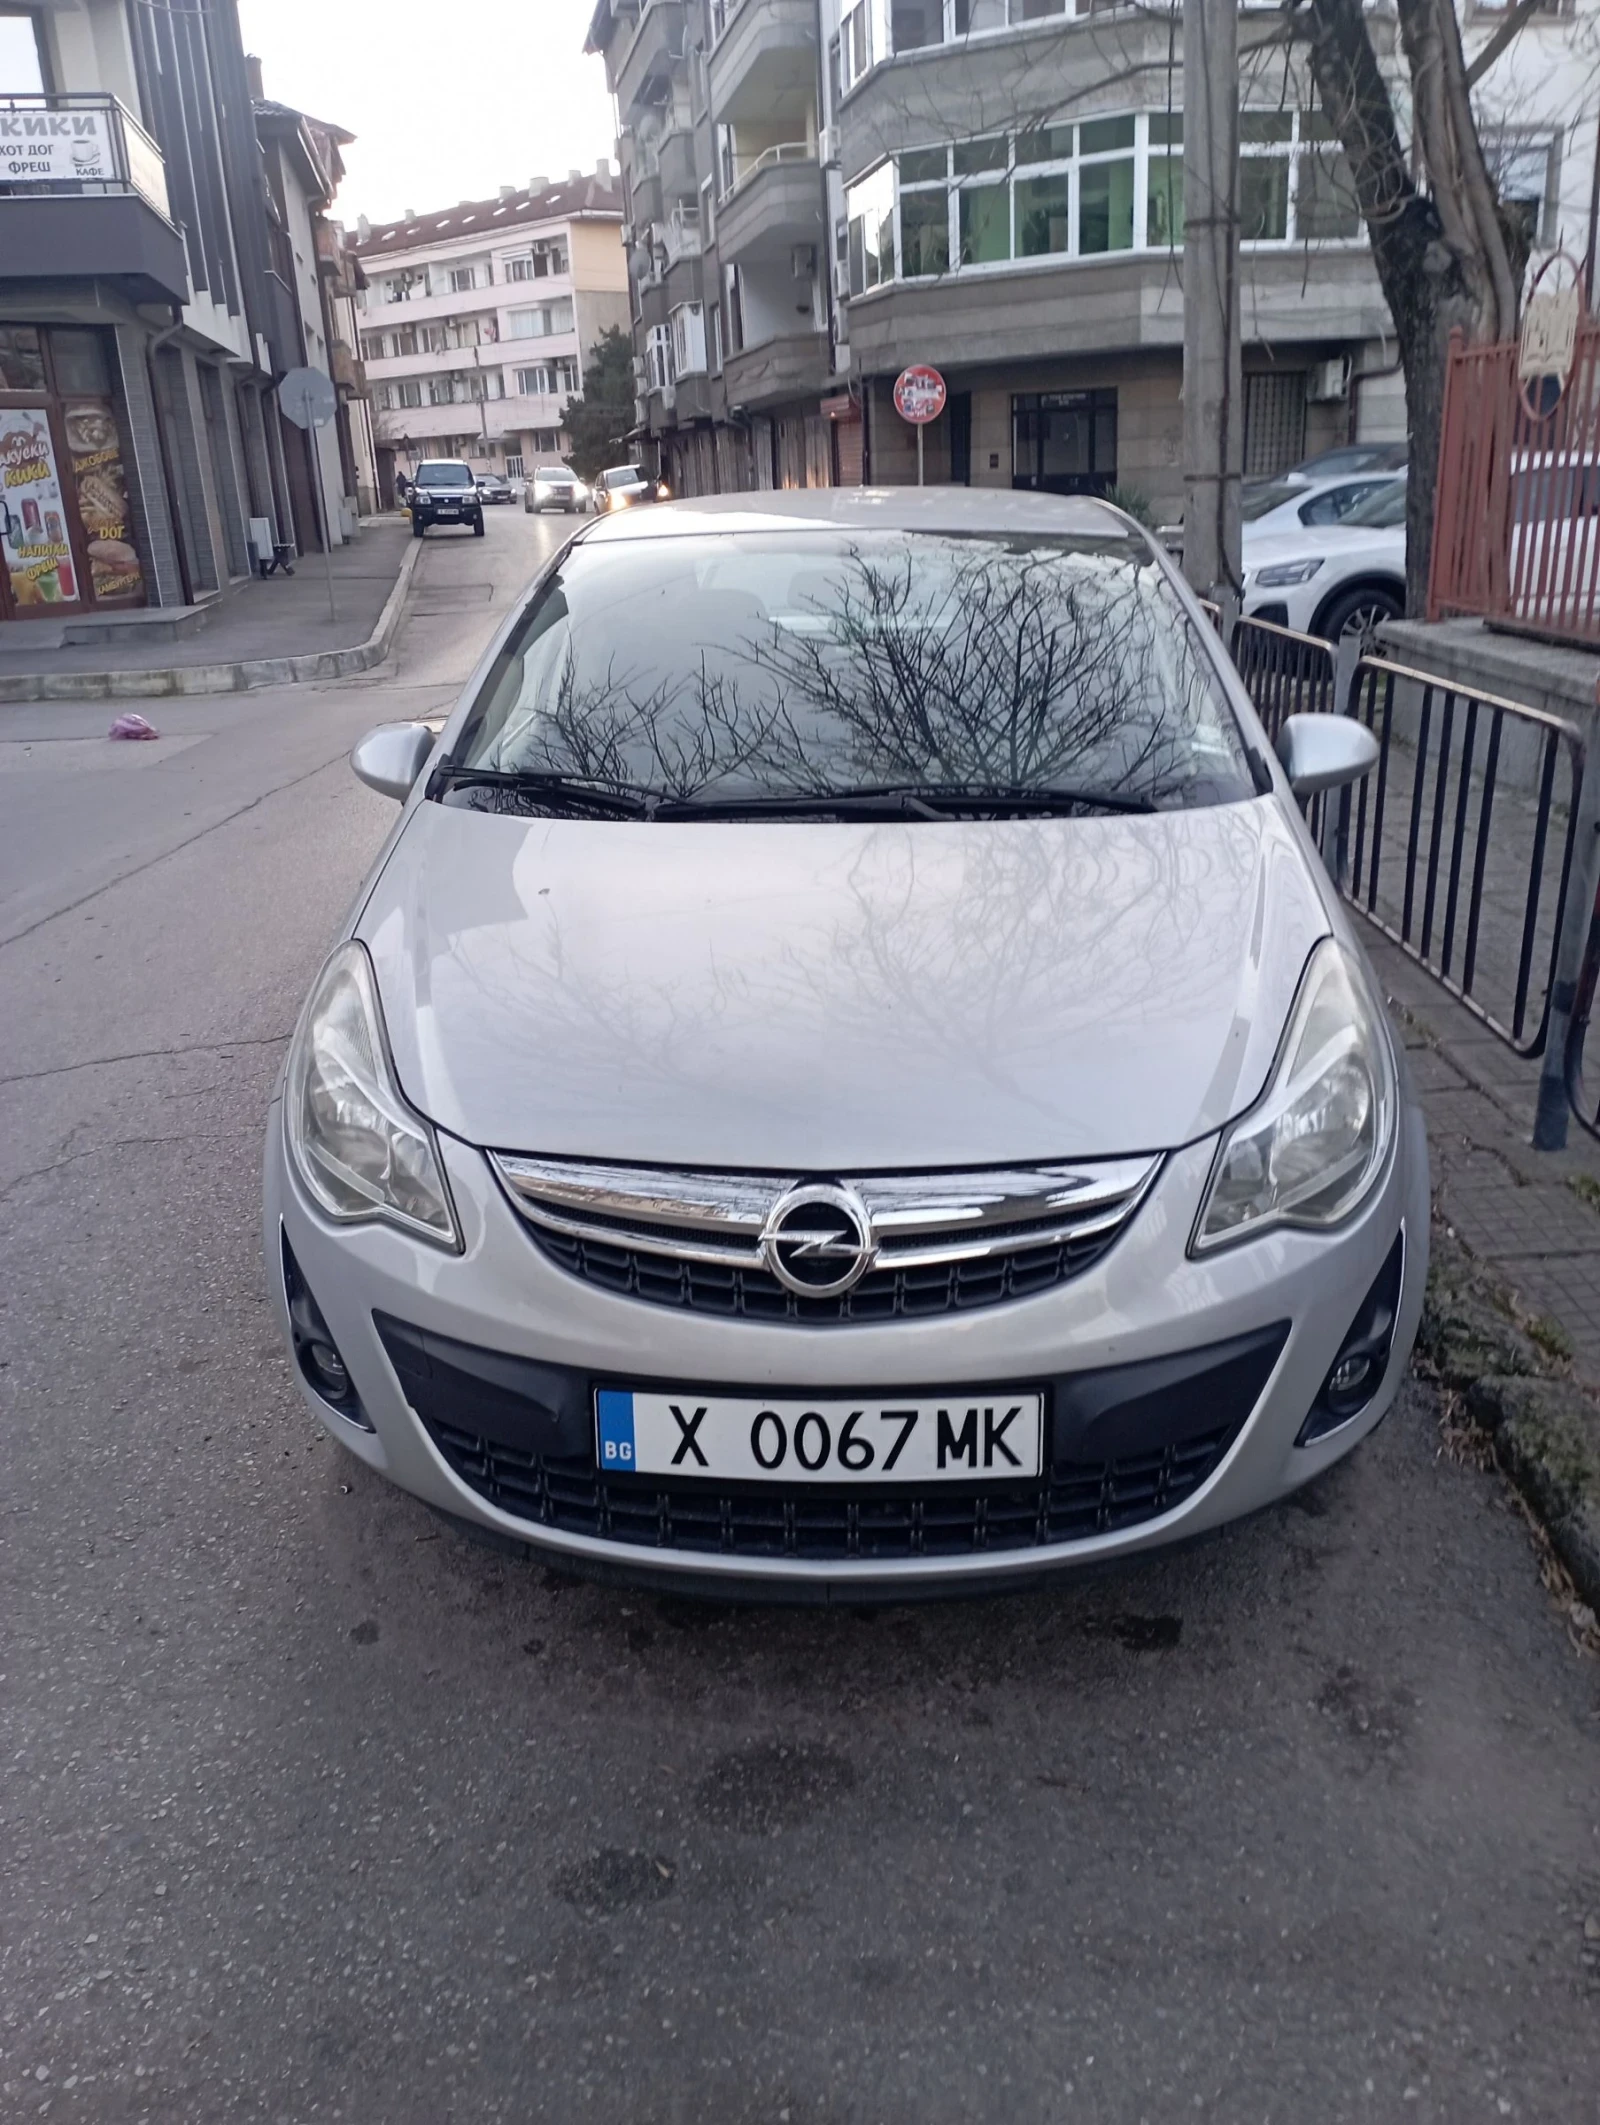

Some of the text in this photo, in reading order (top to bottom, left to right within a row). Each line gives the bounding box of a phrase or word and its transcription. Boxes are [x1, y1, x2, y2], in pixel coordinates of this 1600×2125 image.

[0, 116, 97, 137] КИКИ
[28, 144, 54, 156] ДОГ
[8, 161, 51, 174] ФРЕШ
[75, 167, 105, 176] КАФЕ
[605, 1441, 632, 1460] BG
